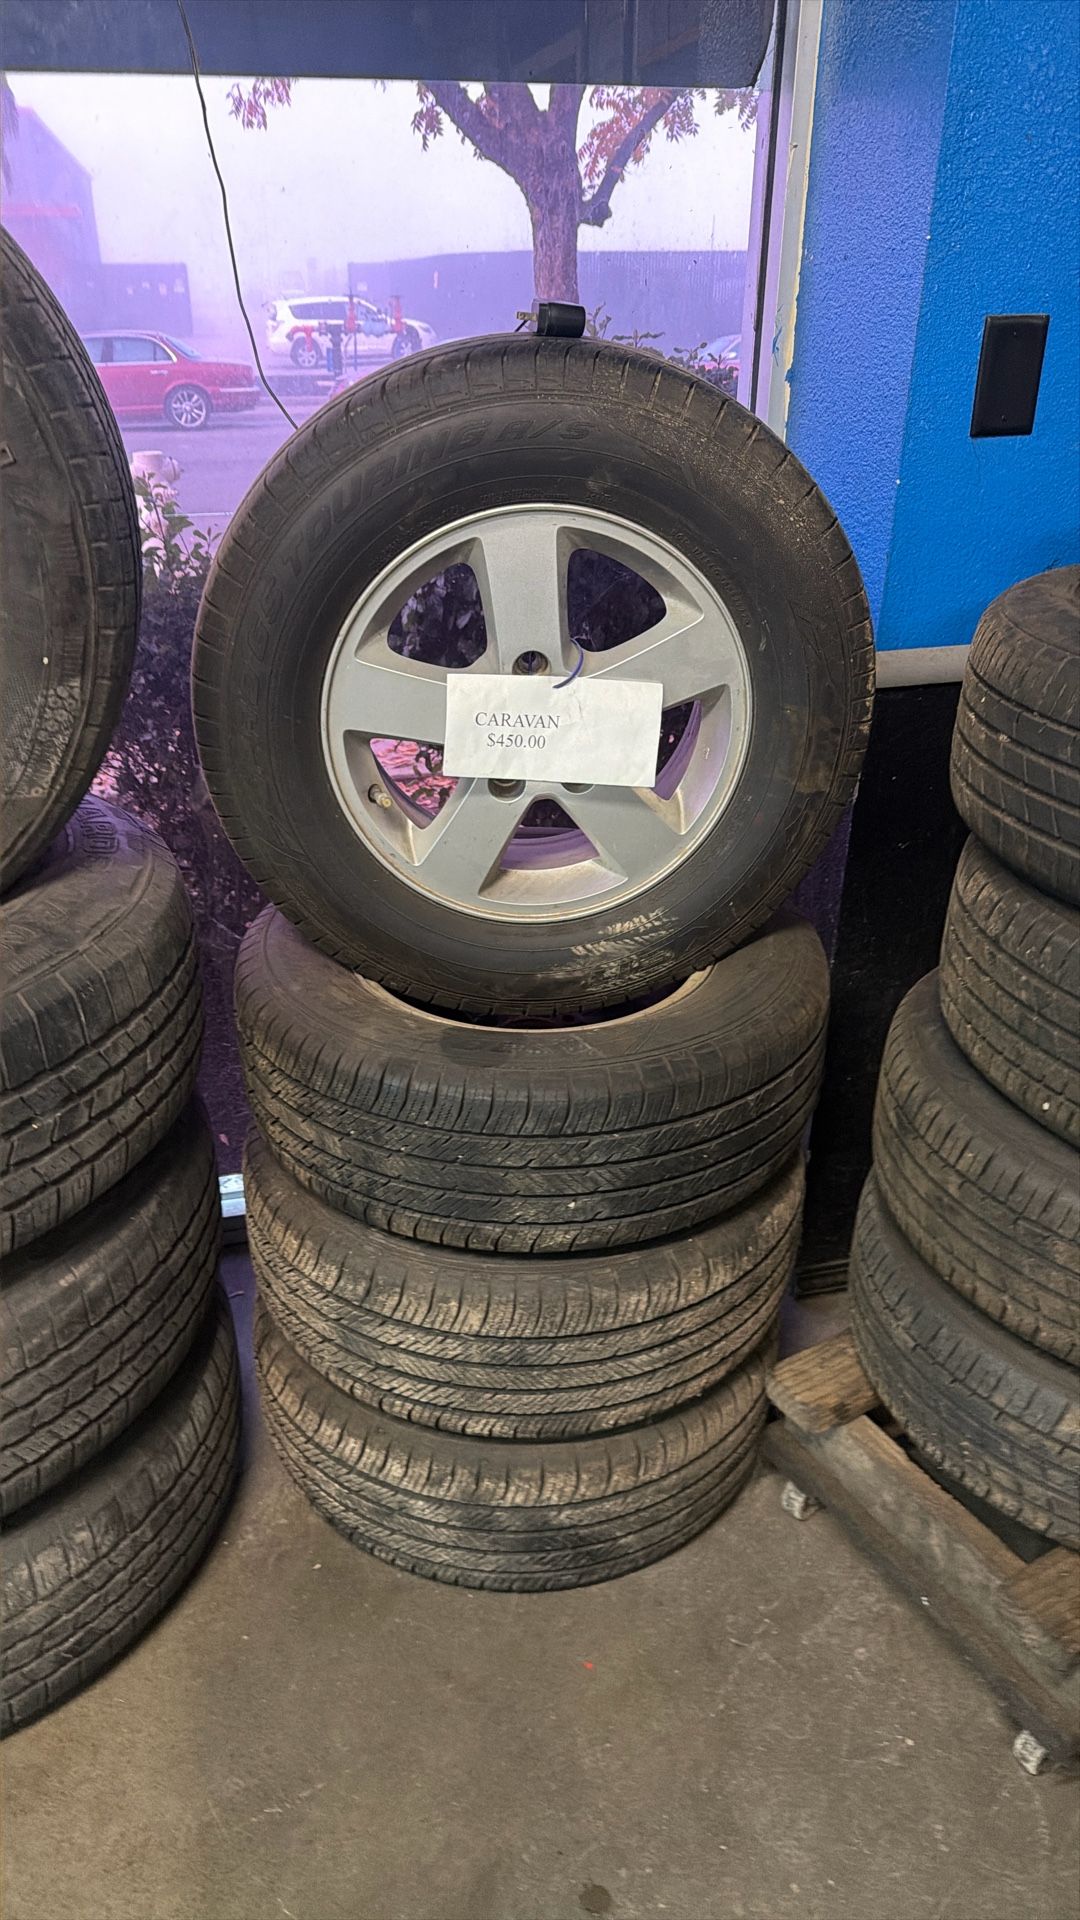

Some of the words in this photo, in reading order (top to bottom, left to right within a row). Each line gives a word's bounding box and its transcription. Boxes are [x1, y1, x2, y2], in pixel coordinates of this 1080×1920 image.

[282, 419, 488, 578] TOURING
[498, 419, 595, 440] A/S
[475, 711, 560, 729] CARAVAN
[486, 732, 546, 749] $450.00
